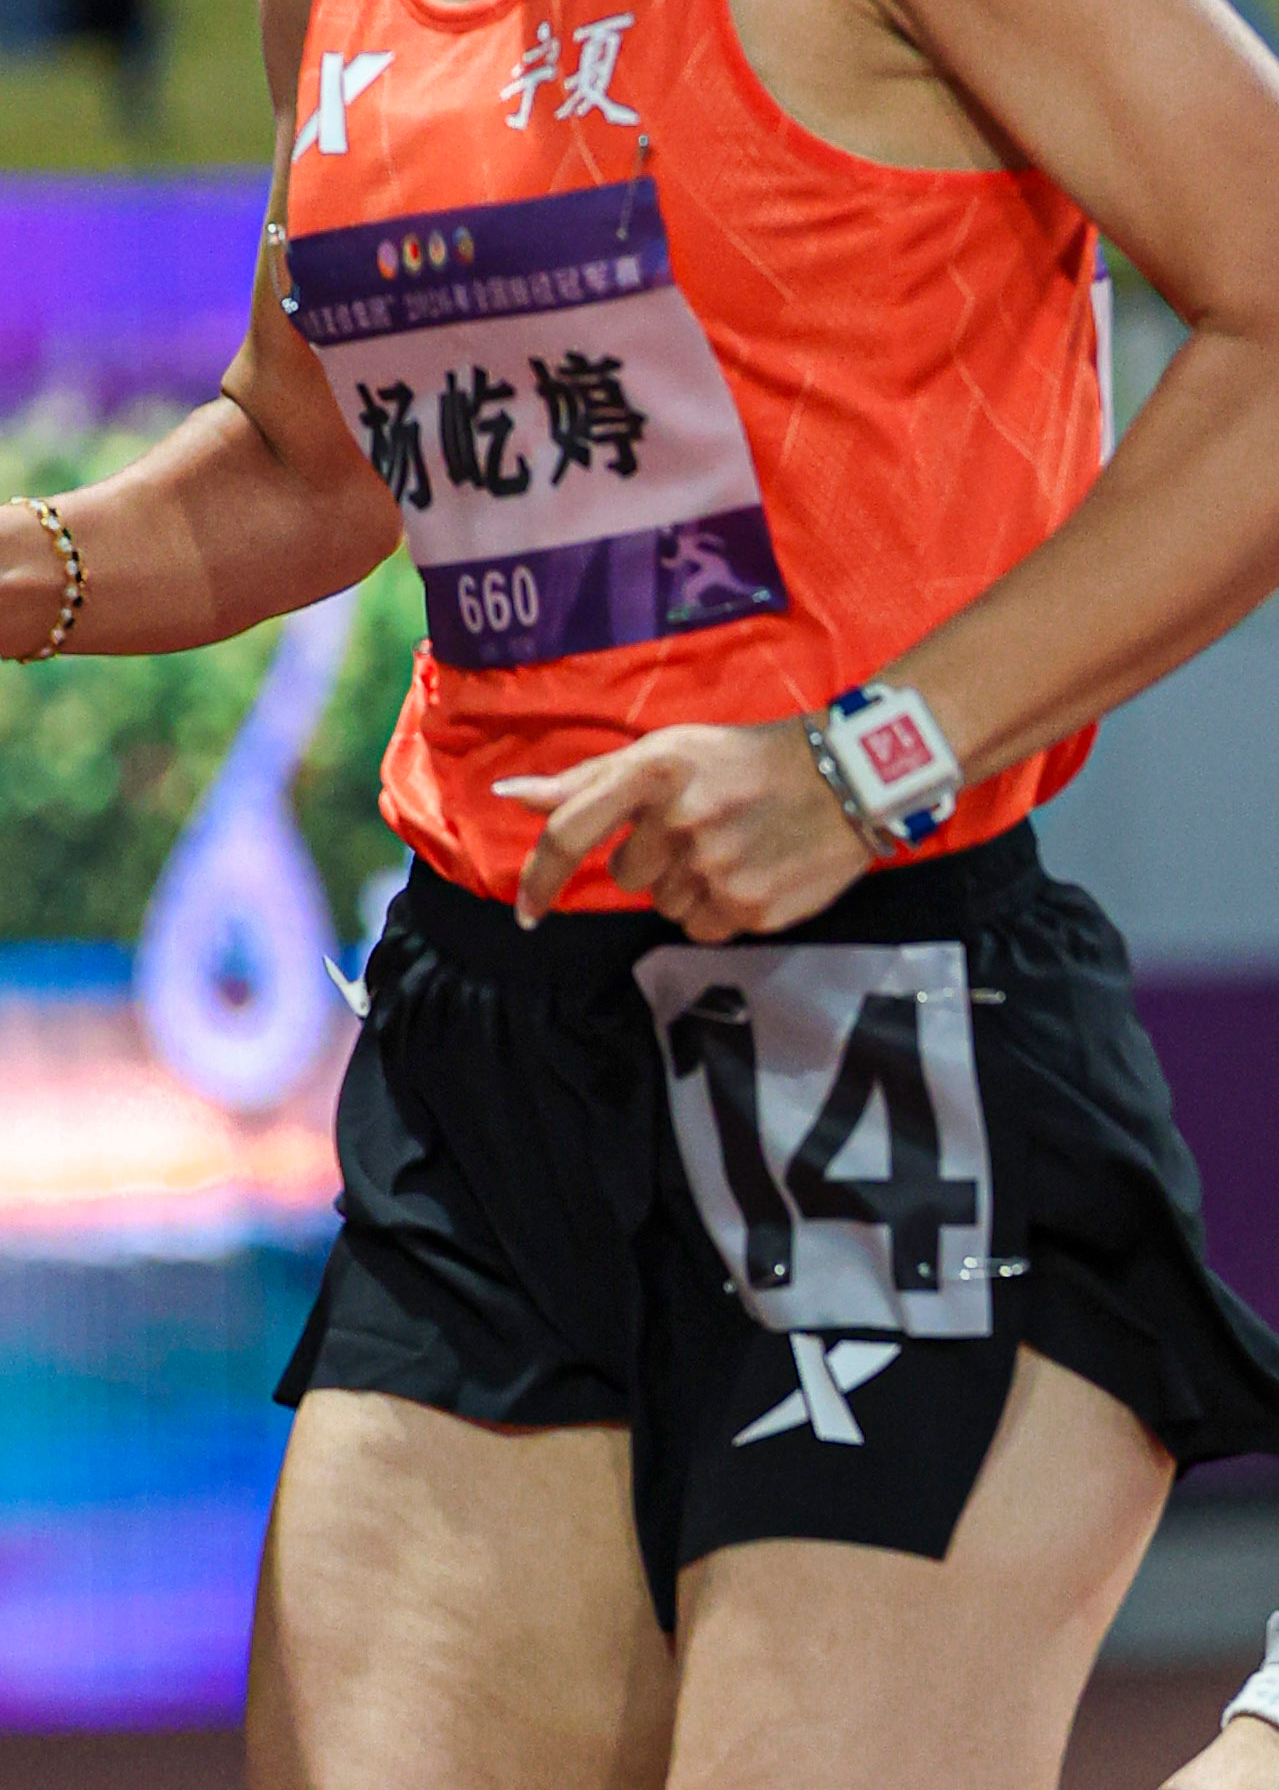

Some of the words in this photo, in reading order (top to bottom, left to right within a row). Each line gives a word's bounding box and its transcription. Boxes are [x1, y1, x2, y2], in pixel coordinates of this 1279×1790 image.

[499, 12, 641, 131] 宁夏
[356, 350, 647, 512] 杨屹婷
[458, 565, 540, 635] 660
[668, 985, 978, 1292] 14
